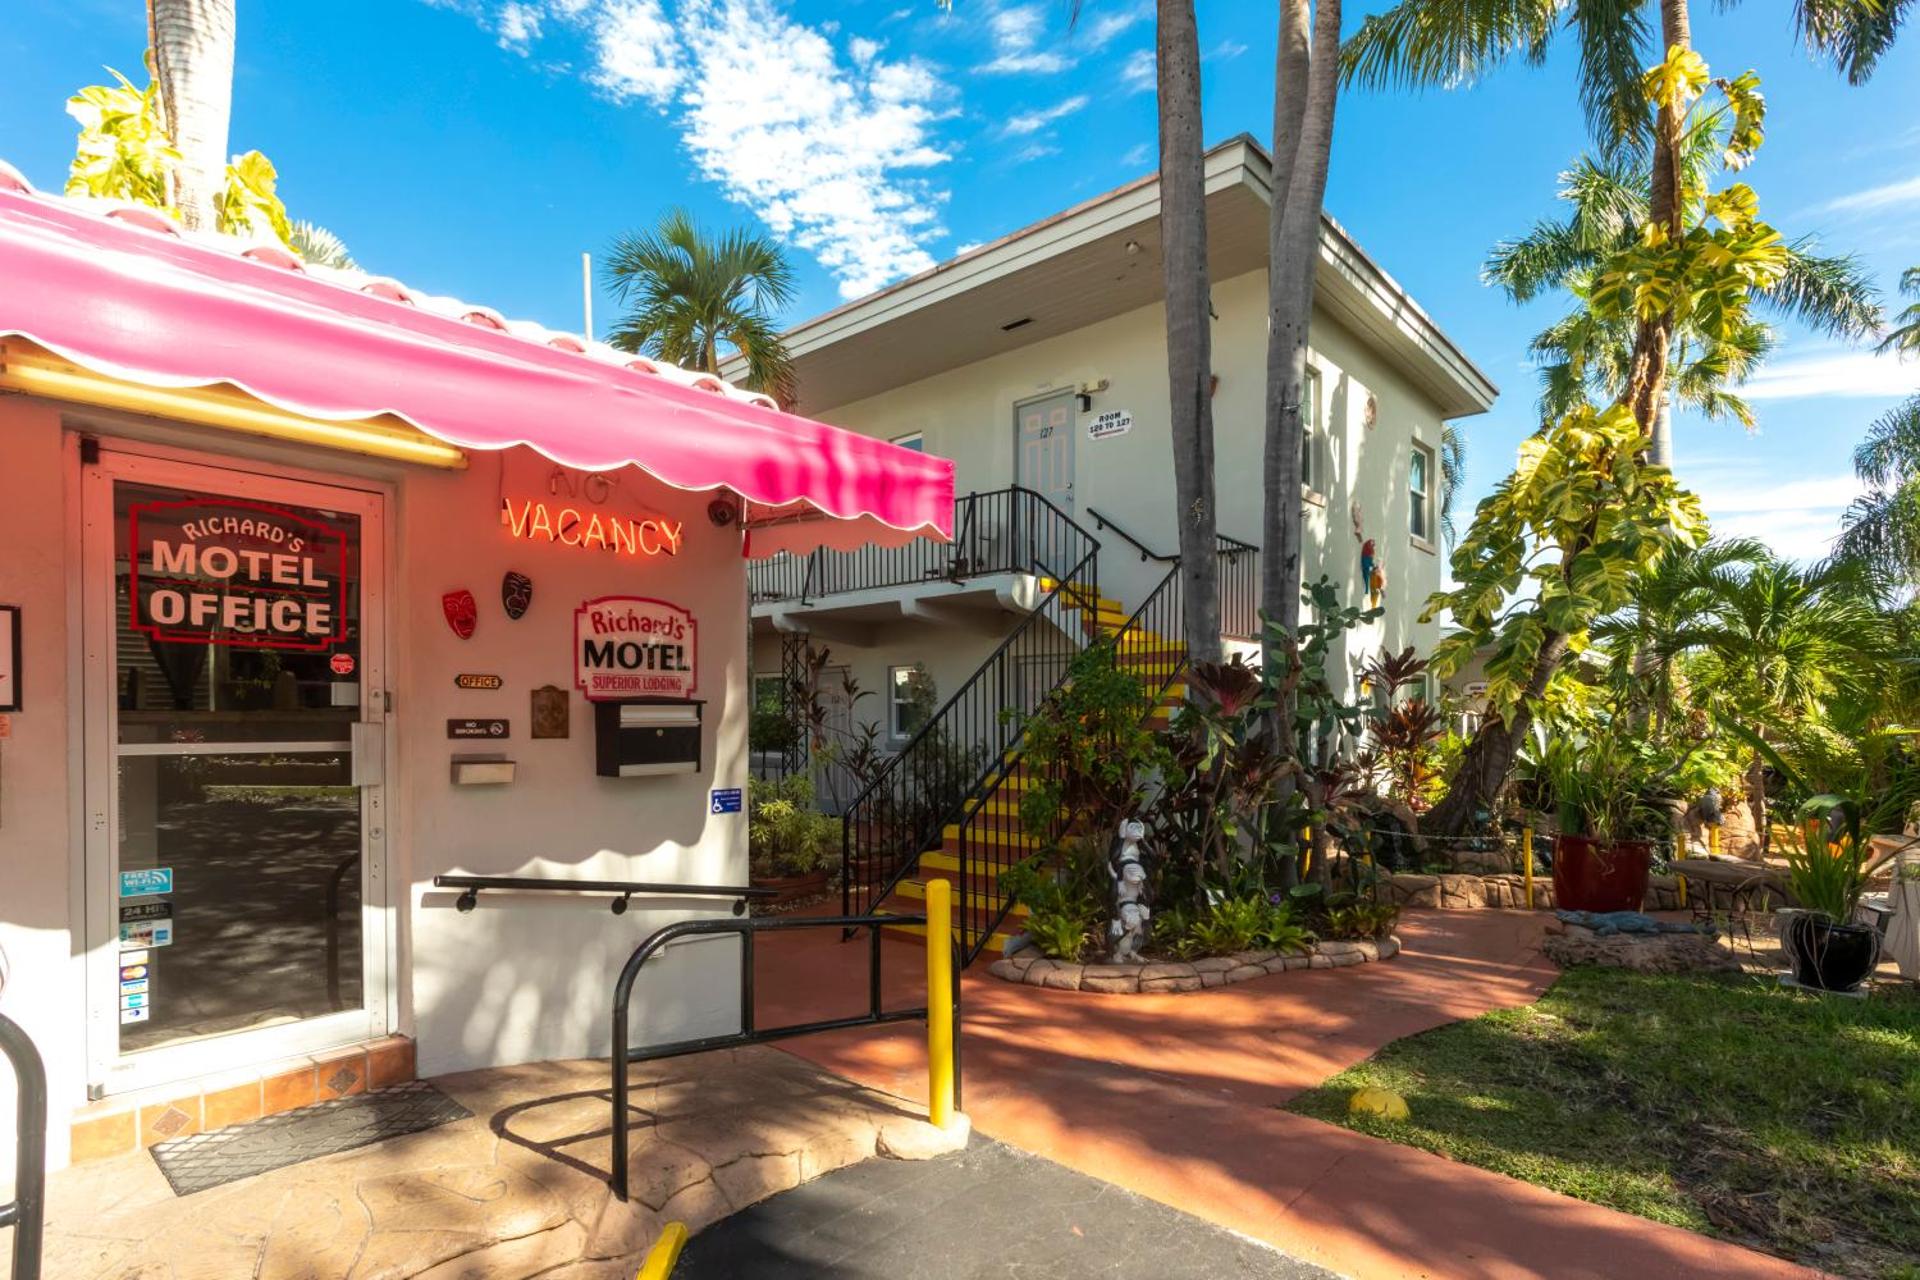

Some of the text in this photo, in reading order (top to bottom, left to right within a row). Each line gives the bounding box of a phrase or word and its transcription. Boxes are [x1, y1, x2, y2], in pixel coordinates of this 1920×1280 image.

[1040, 426, 1053, 439] 127
[1098, 411, 1121, 423] ROOM
[1105, 422, 1114, 430] TO
[1116, 418, 1130, 427] 127
[182, 516, 305, 553] RICHARD'S
[504, 498, 683, 556] VACANCY
[152, 539, 329, 588] MOTEL
[150, 589, 331, 635] OFFICE
[590, 608, 685, 640] Richard's
[583, 639, 691, 672] MOTEL
[461, 676, 497, 687] OFFICE
[592, 675, 682, 691] SUPERIOR LODGING
